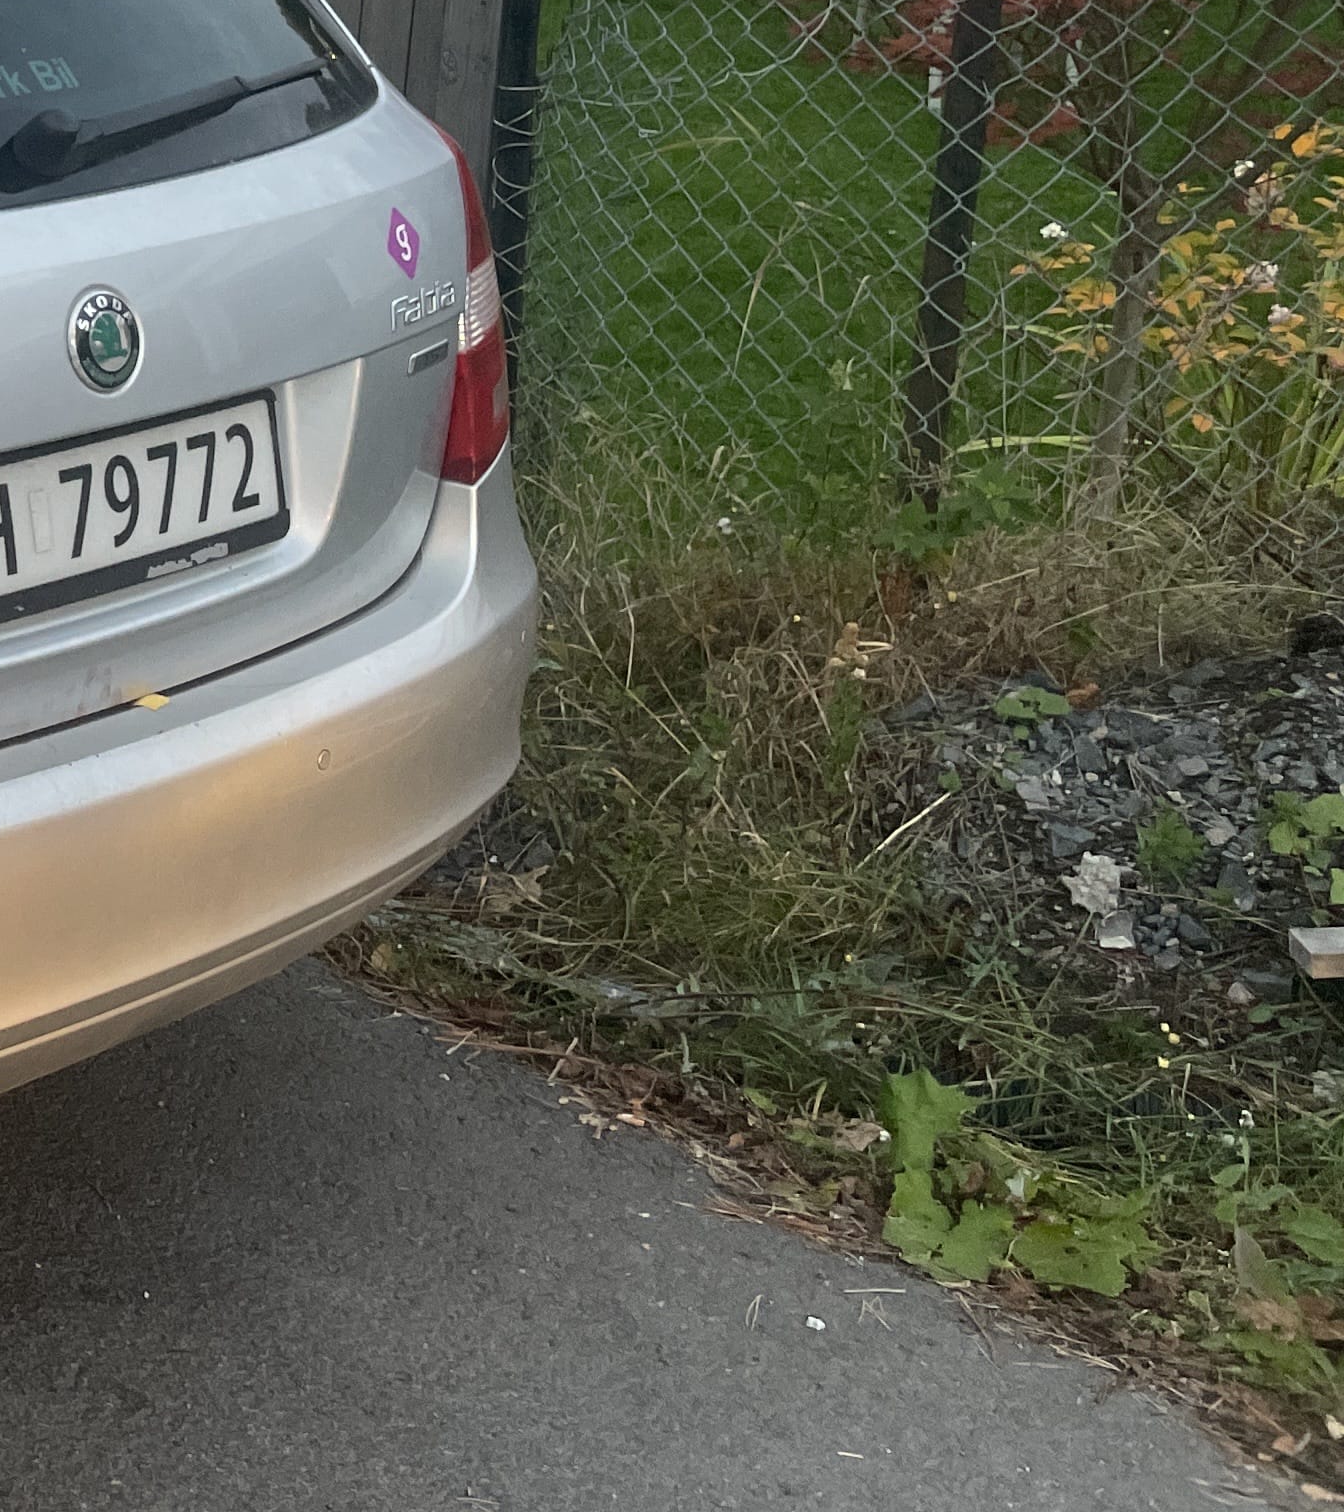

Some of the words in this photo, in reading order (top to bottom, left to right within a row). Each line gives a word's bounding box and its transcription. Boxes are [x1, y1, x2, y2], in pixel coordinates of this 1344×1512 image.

[28, 57, 80, 92] Bil
[395, 223, 413, 262] g
[391, 280, 456, 333] Fabia
[58, 422, 261, 560] 79772
